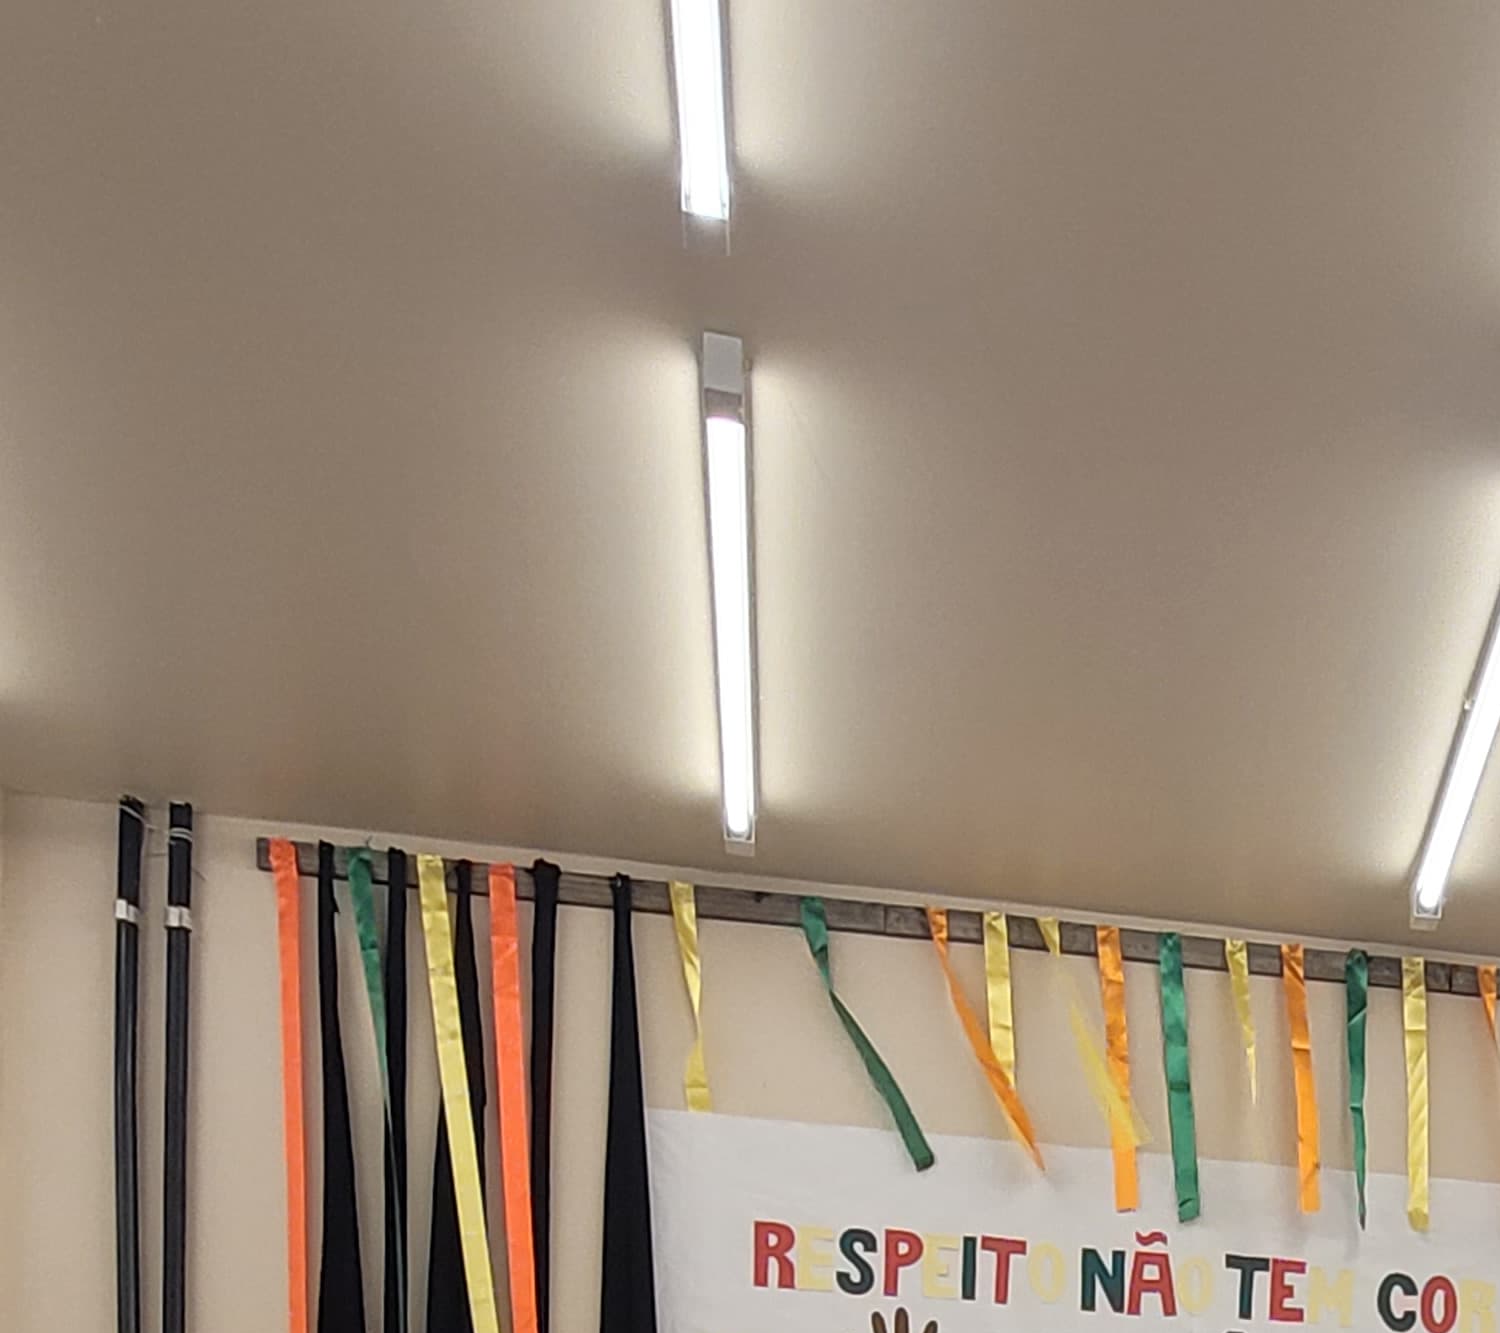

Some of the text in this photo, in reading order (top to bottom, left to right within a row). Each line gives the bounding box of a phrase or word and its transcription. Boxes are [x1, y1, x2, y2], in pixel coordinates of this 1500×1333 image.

[753, 1219, 1065, 1305] RESPEITO
[1080, 1229, 1214, 1317] NÃO
[1226, 1253, 1354, 1328] TEM
